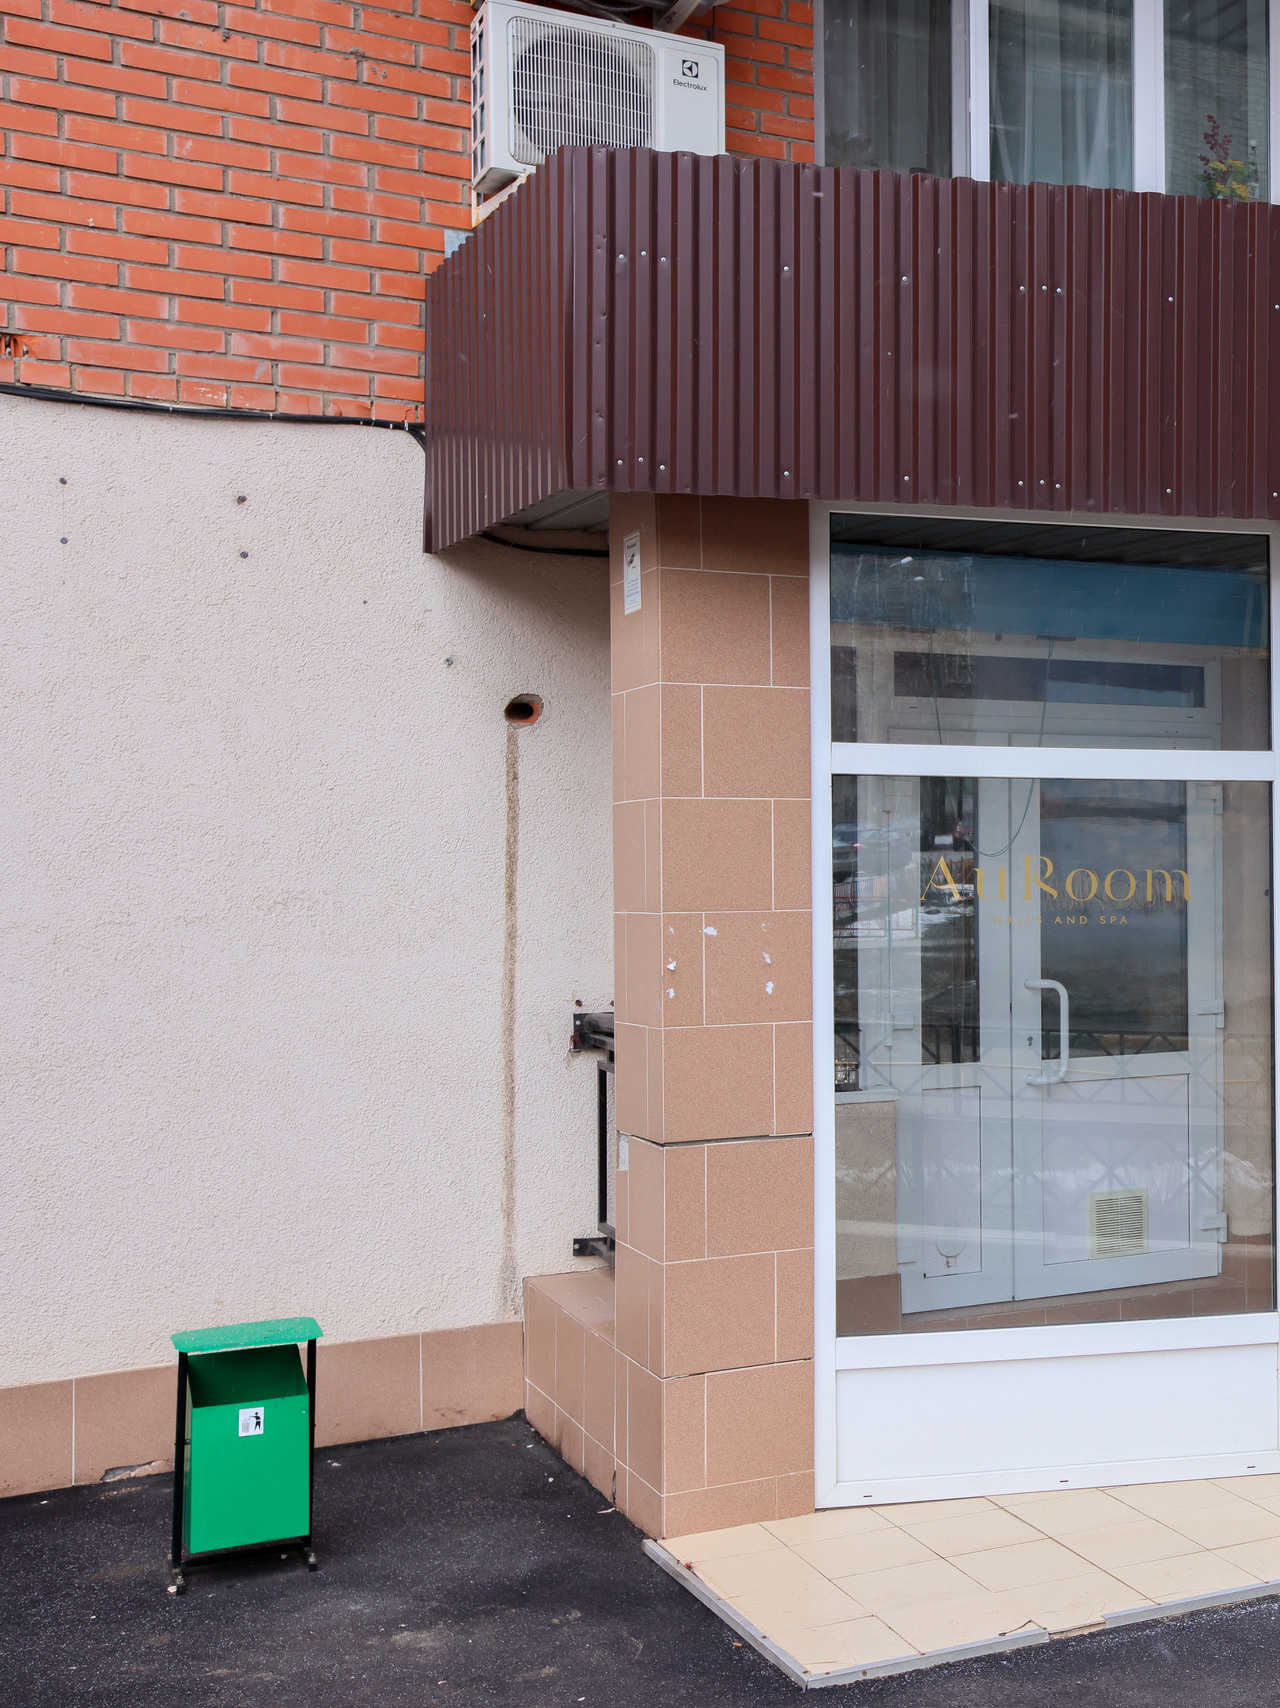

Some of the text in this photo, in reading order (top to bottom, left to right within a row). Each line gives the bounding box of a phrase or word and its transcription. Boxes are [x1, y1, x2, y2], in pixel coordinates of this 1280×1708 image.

[673, 79, 707, 91] Electrolux
[920, 855, 1193, 902] AuRoom
[993, 915, 1129, 925] NAILS AND SPA
